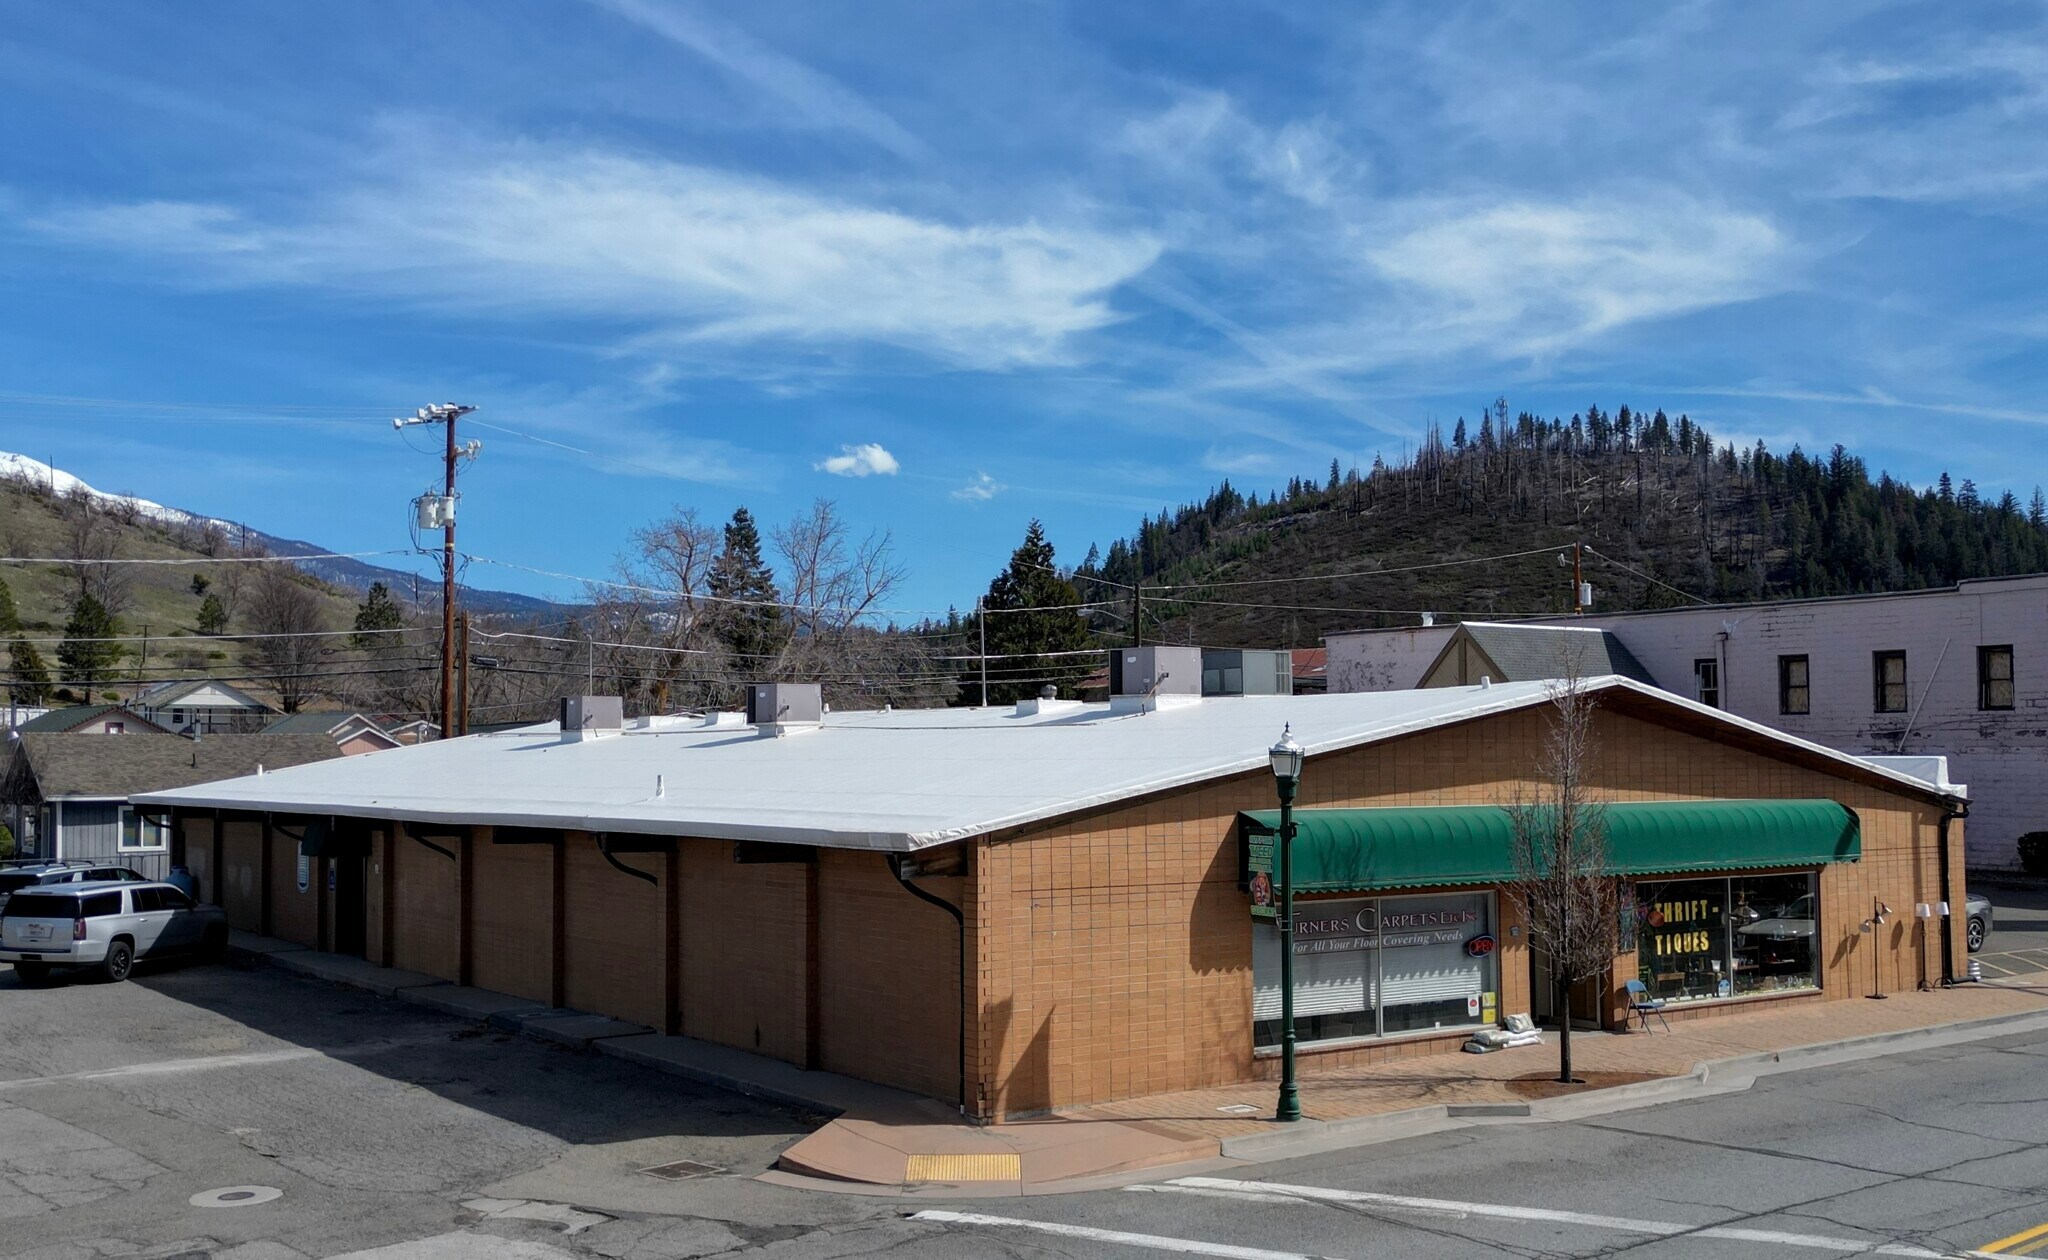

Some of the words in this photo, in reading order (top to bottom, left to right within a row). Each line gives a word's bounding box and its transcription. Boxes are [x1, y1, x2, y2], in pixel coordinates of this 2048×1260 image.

[1355, 907, 1437, 933] CARPETS
[1292, 942, 1308, 953] For
[1311, 940, 1326, 951] All
[1329, 940, 1350, 950] Your
[1353, 938, 1378, 948] Floor
[1383, 933, 1430, 945] Covering
[1433, 930, 1464, 942] Needs
[1469, 939, 1495, 953] OPEN
[1655, 930, 1709, 956] TIQUES
